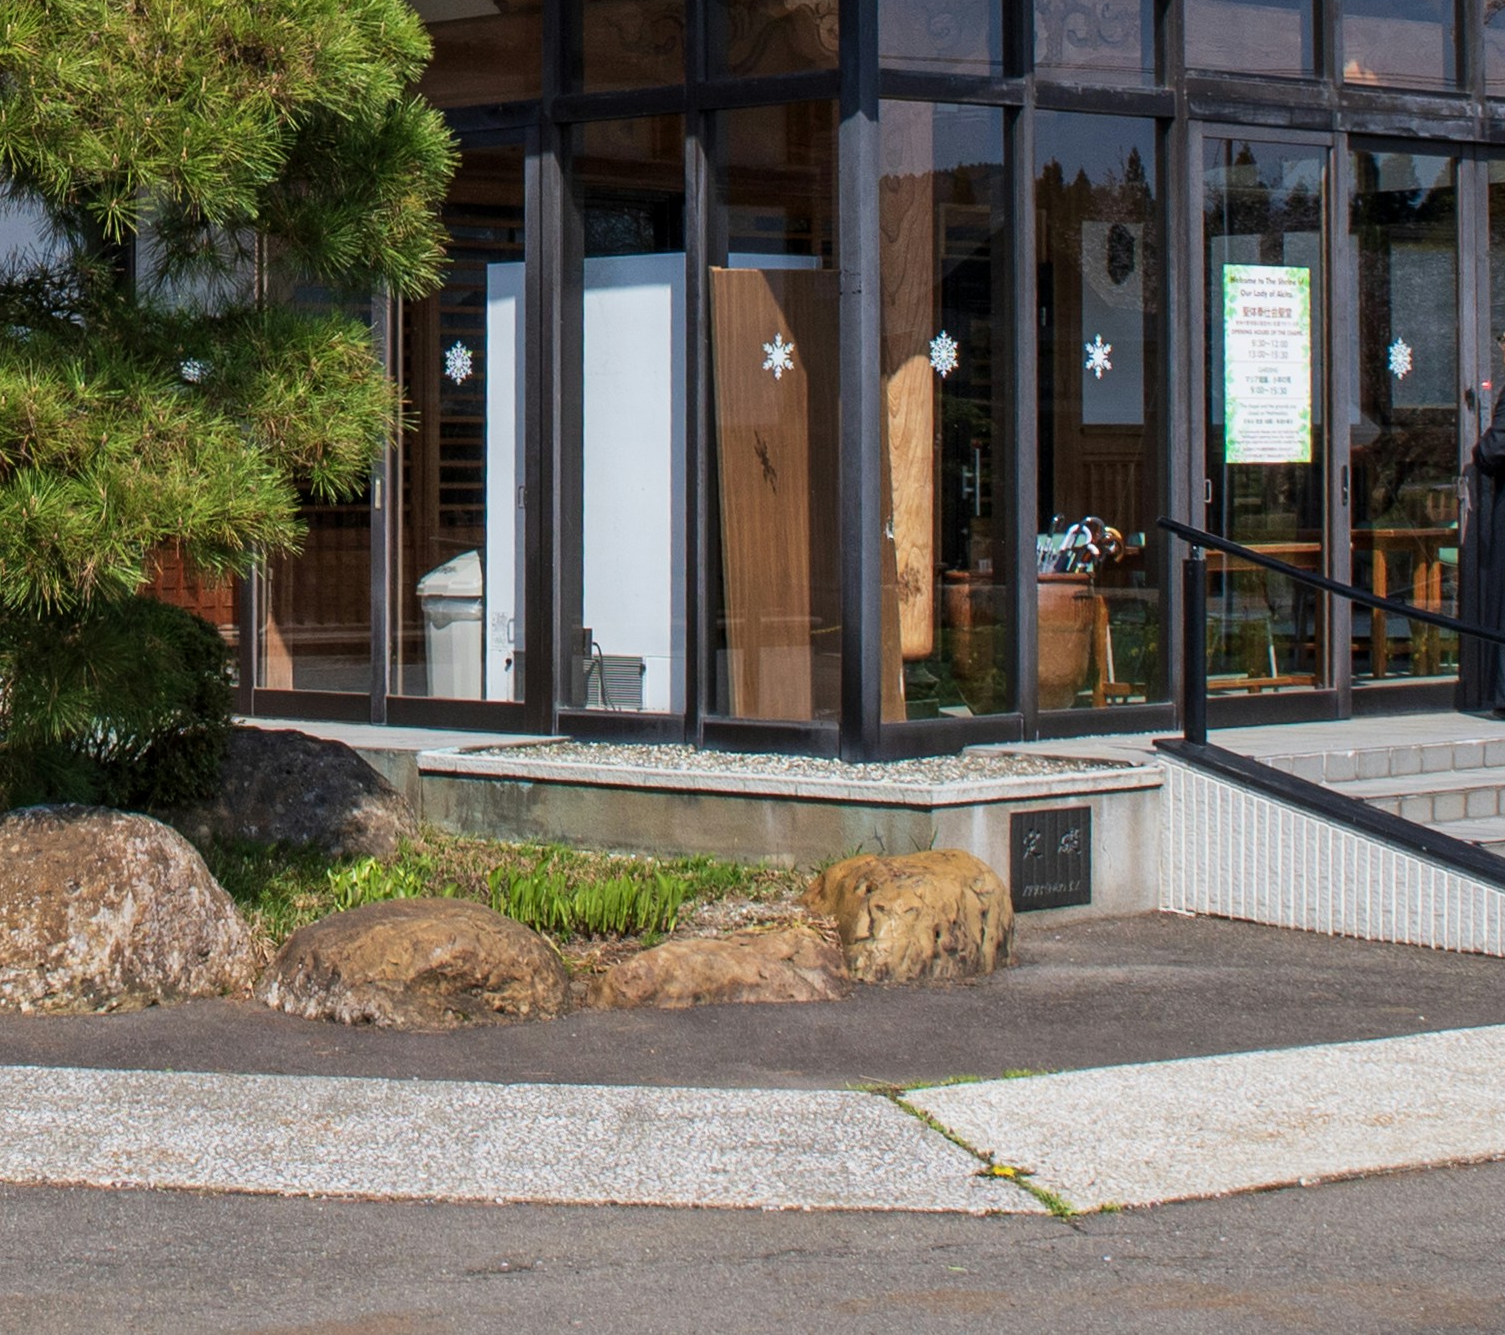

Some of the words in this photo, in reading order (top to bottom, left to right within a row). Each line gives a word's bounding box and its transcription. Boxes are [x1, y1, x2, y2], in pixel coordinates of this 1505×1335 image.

[1230, 276, 1256, 284] Welcome
[1279, 278, 1296, 286] Shrine
[1240, 289, 1252, 297] Our
[1253, 290, 1267, 298] Lady
[1269, 290, 1276, 298] of
